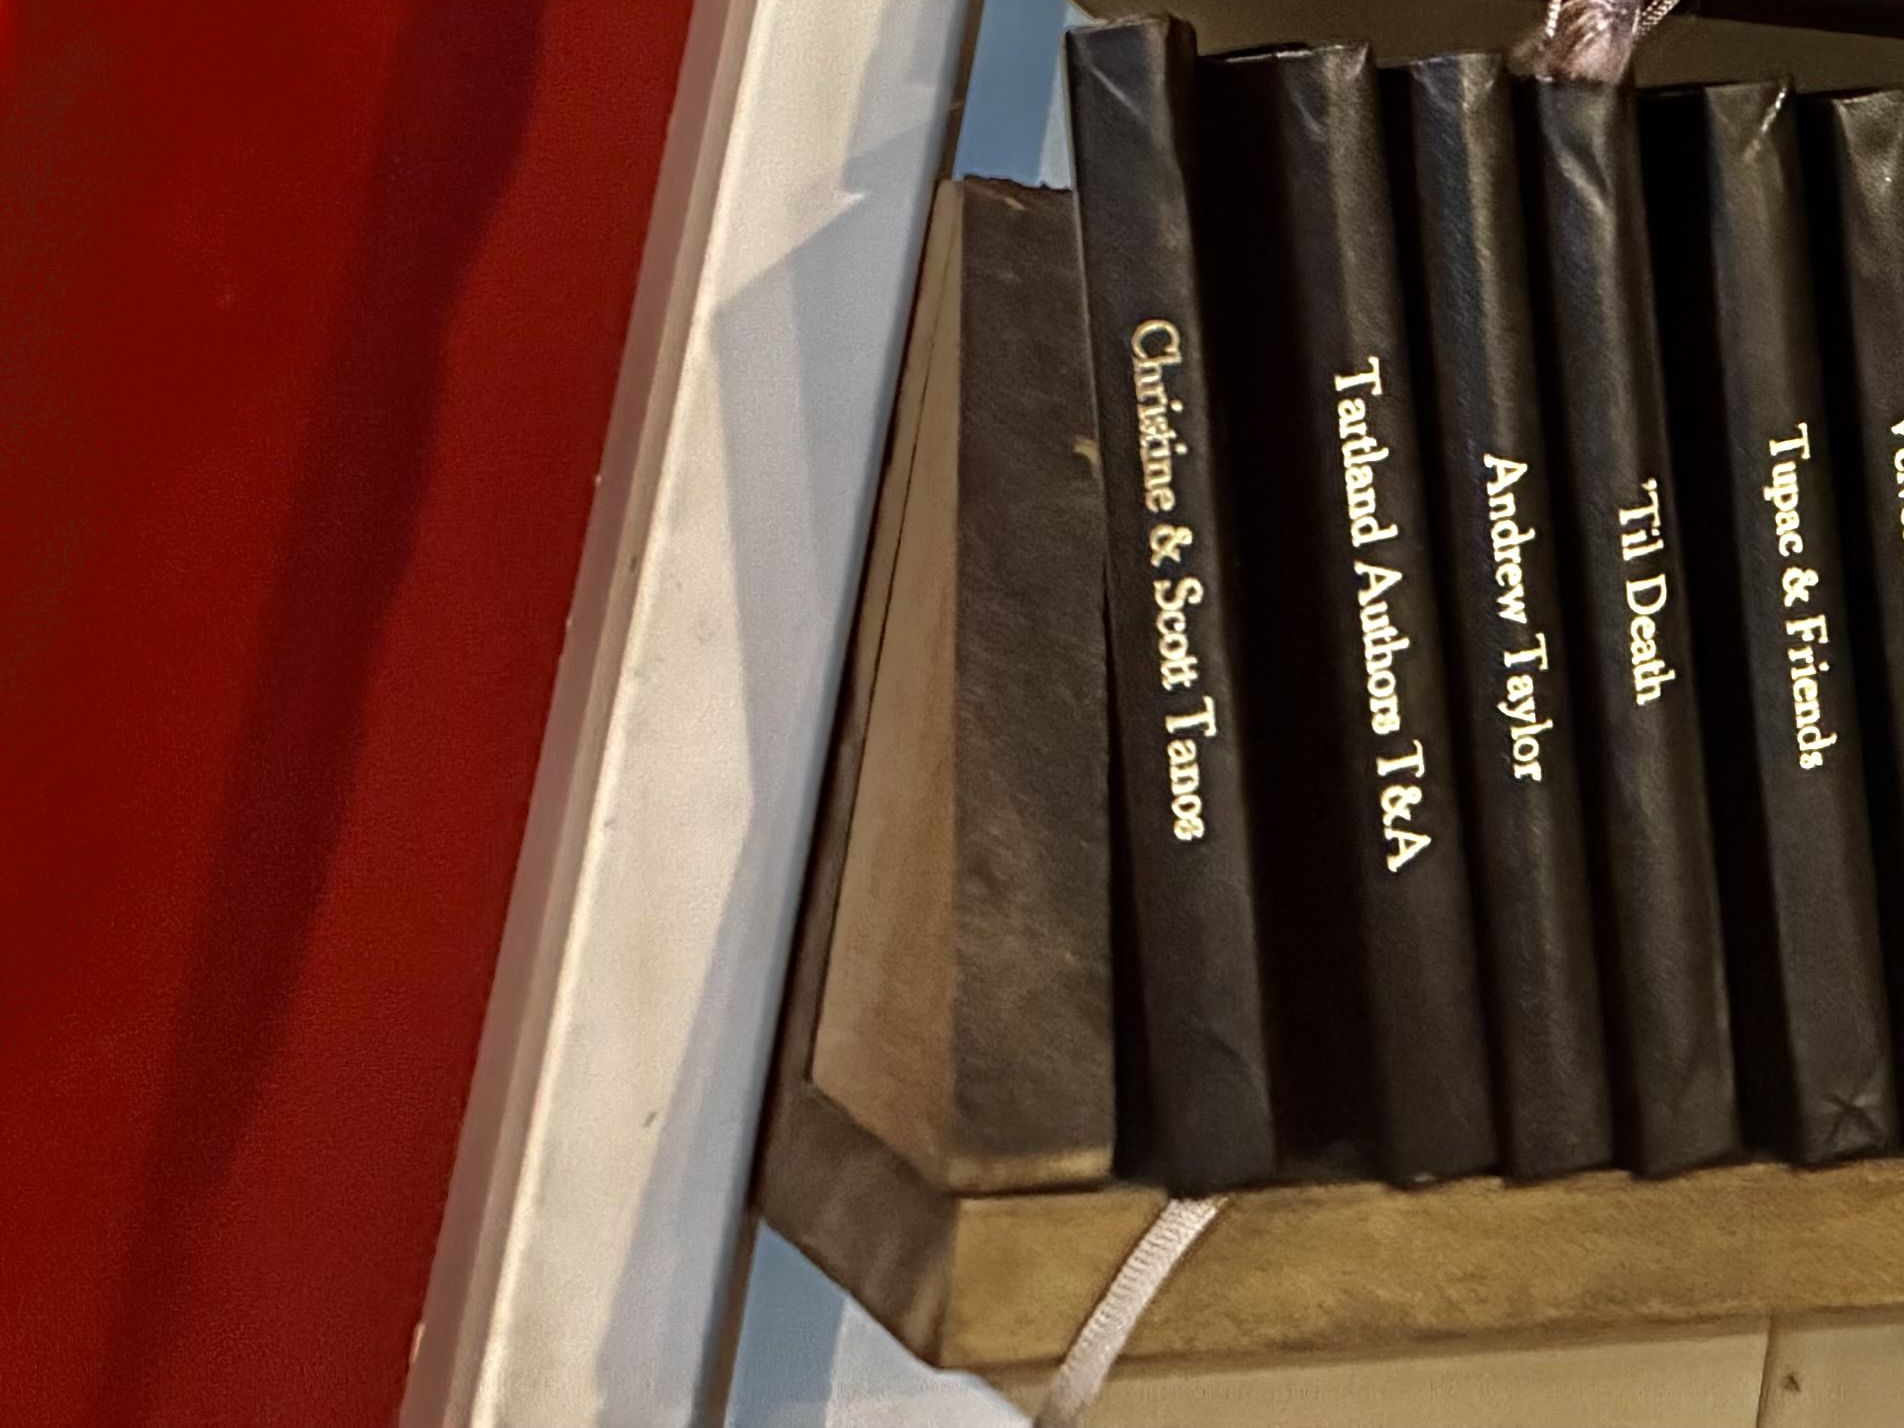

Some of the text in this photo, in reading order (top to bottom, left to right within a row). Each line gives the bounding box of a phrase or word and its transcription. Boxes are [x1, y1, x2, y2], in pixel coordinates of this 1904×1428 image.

[1131, 319, 1217, 841] Christine & Scott Tanos
[1333, 355, 1432, 873] Tartland Authors T&A
[1482, 452, 1554, 782] Andrew Taylor
[1625, 573, 1676, 706] Death
